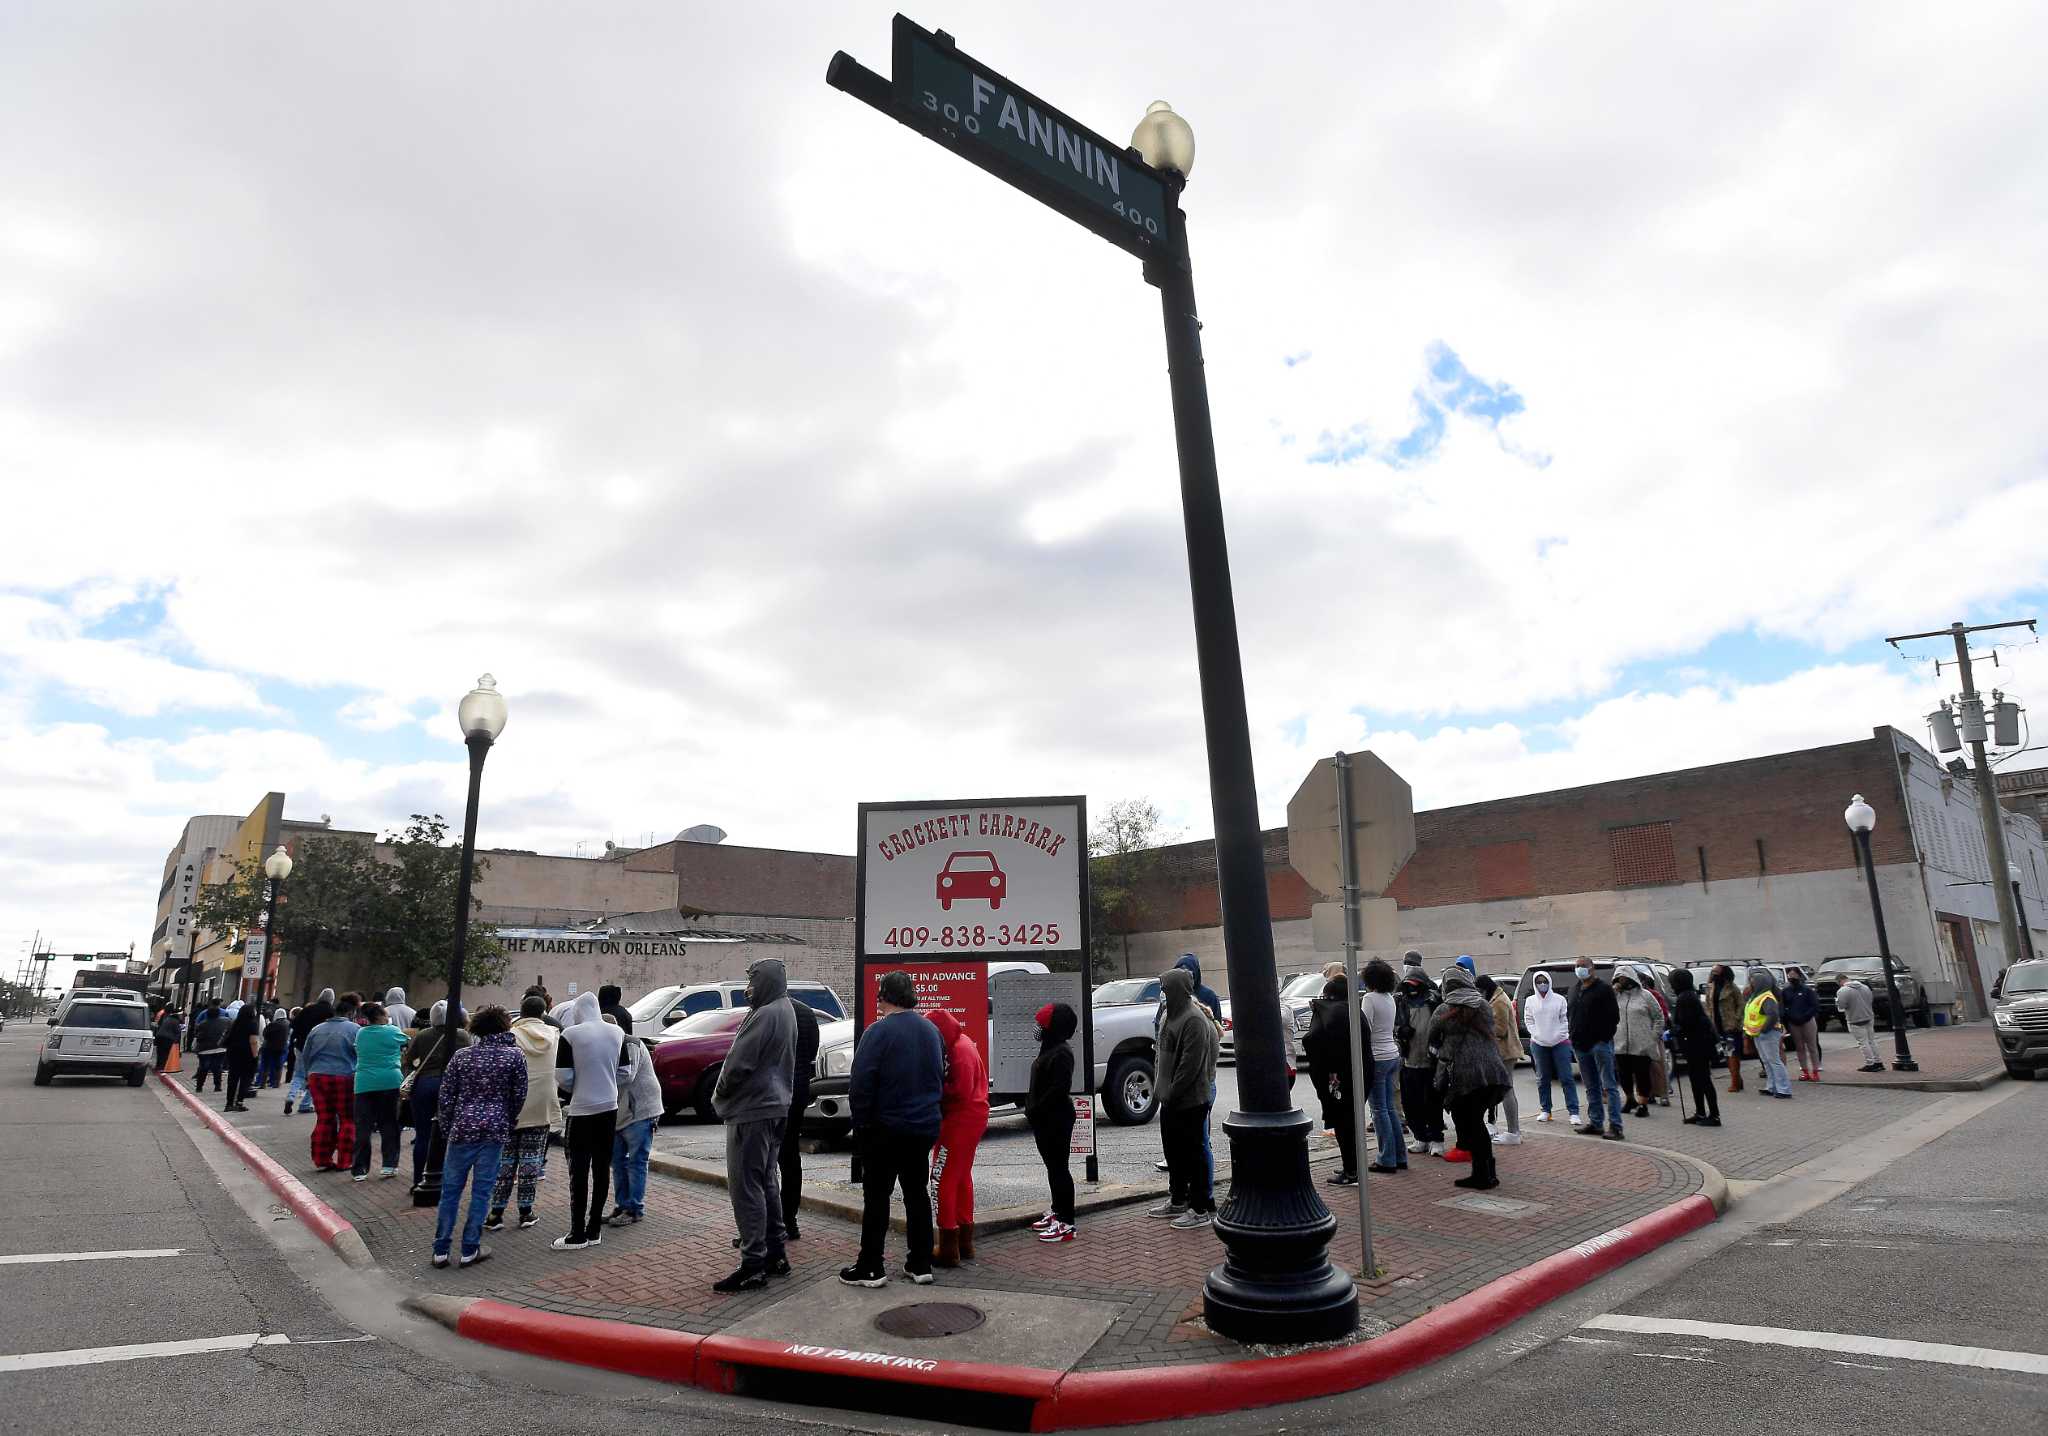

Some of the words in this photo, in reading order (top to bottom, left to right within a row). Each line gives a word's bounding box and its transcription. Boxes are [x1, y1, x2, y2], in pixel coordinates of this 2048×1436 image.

[923, 90, 981, 134] 300
[971, 74, 1121, 195] FANNIN
[1112, 200, 1159, 235] 400
[878, 814, 970, 861] CROCKETT
[979, 813, 1067, 857] CARPARK
[176, 864, 194, 936] ANTIQUE
[532, 939, 593, 954] MARKET
[600, 942, 620, 955] ON
[625, 942, 687, 957] ORLEANS
[884, 923, 1060, 947] 409-838-3425
[920, 973, 930, 981] IN
[932, 972, 977, 981] ADVANCE
[784, 1343, 825, 1356] NO
[825, 1348, 938, 1372] PARKING
